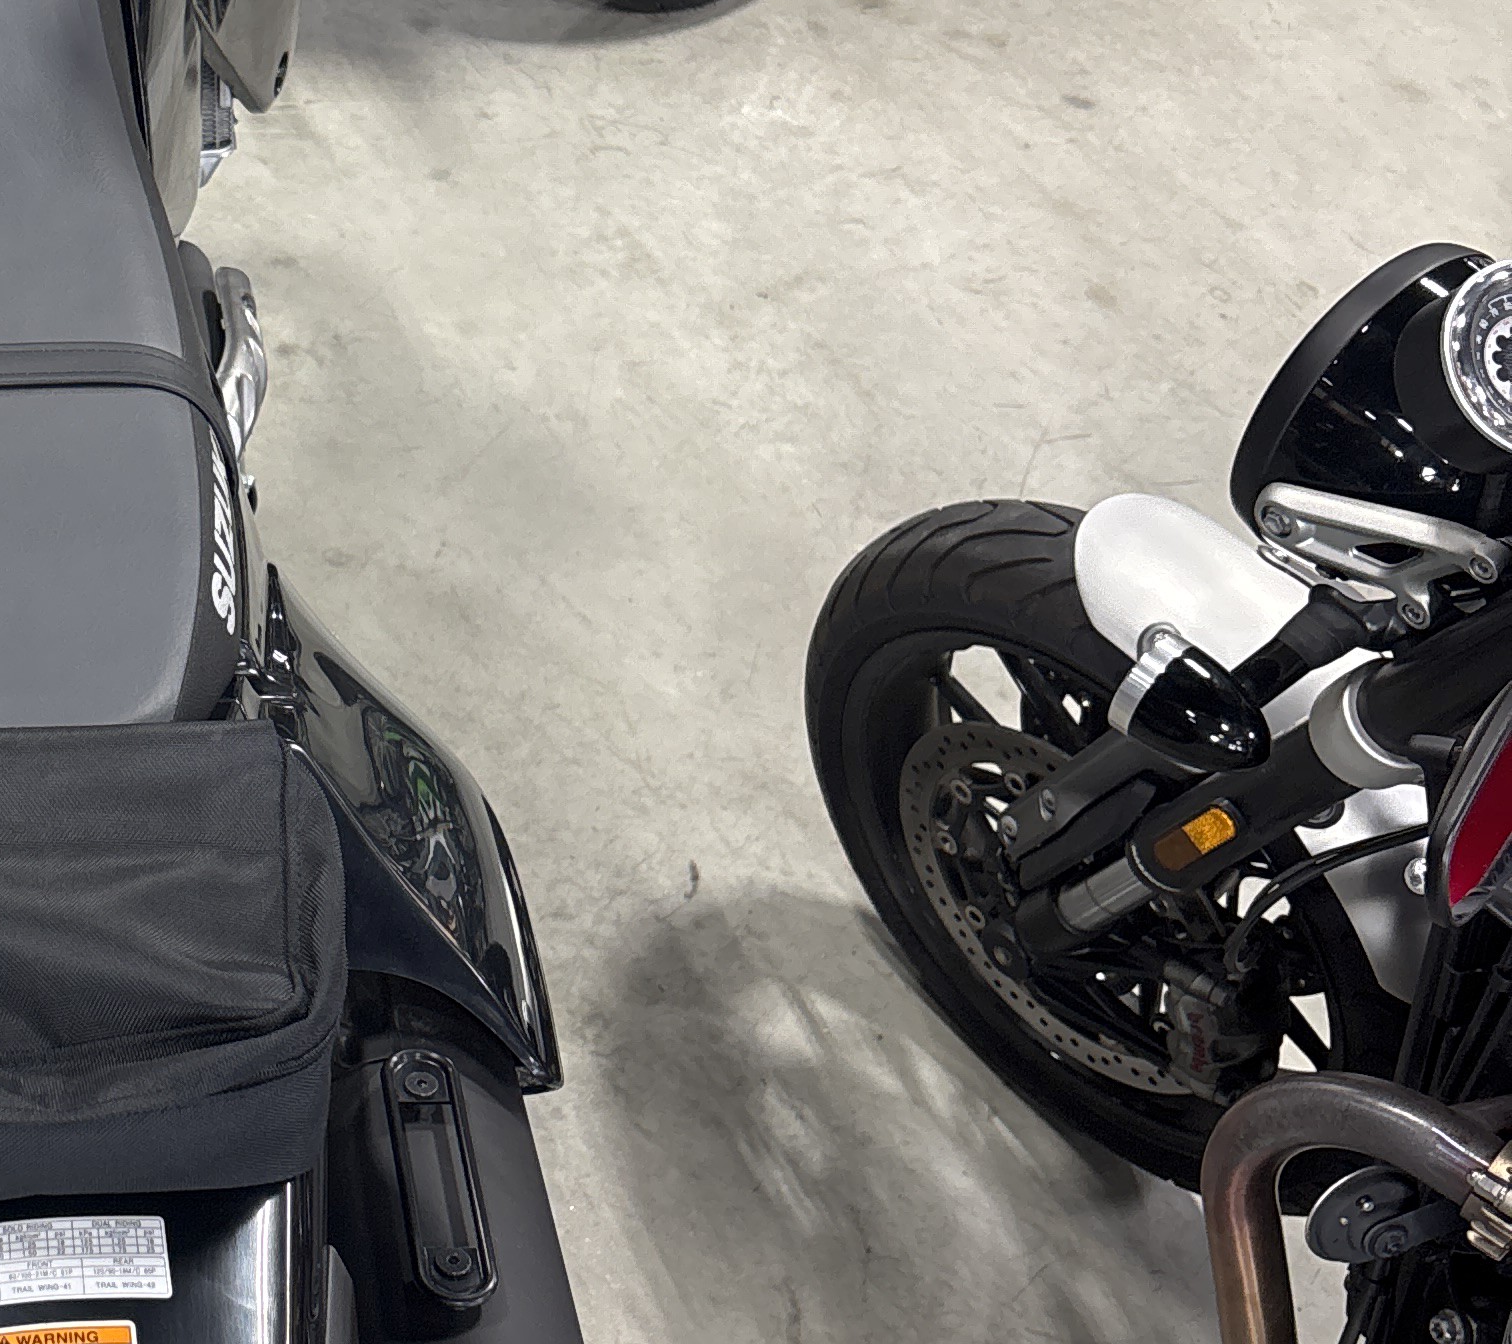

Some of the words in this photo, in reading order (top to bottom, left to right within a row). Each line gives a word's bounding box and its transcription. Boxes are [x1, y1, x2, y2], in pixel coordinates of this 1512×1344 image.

[209, 424, 236, 636] SUZUK
[11, 1284, 34, 1295] TRAIL
[95, 1281, 119, 1289] TRAIL
